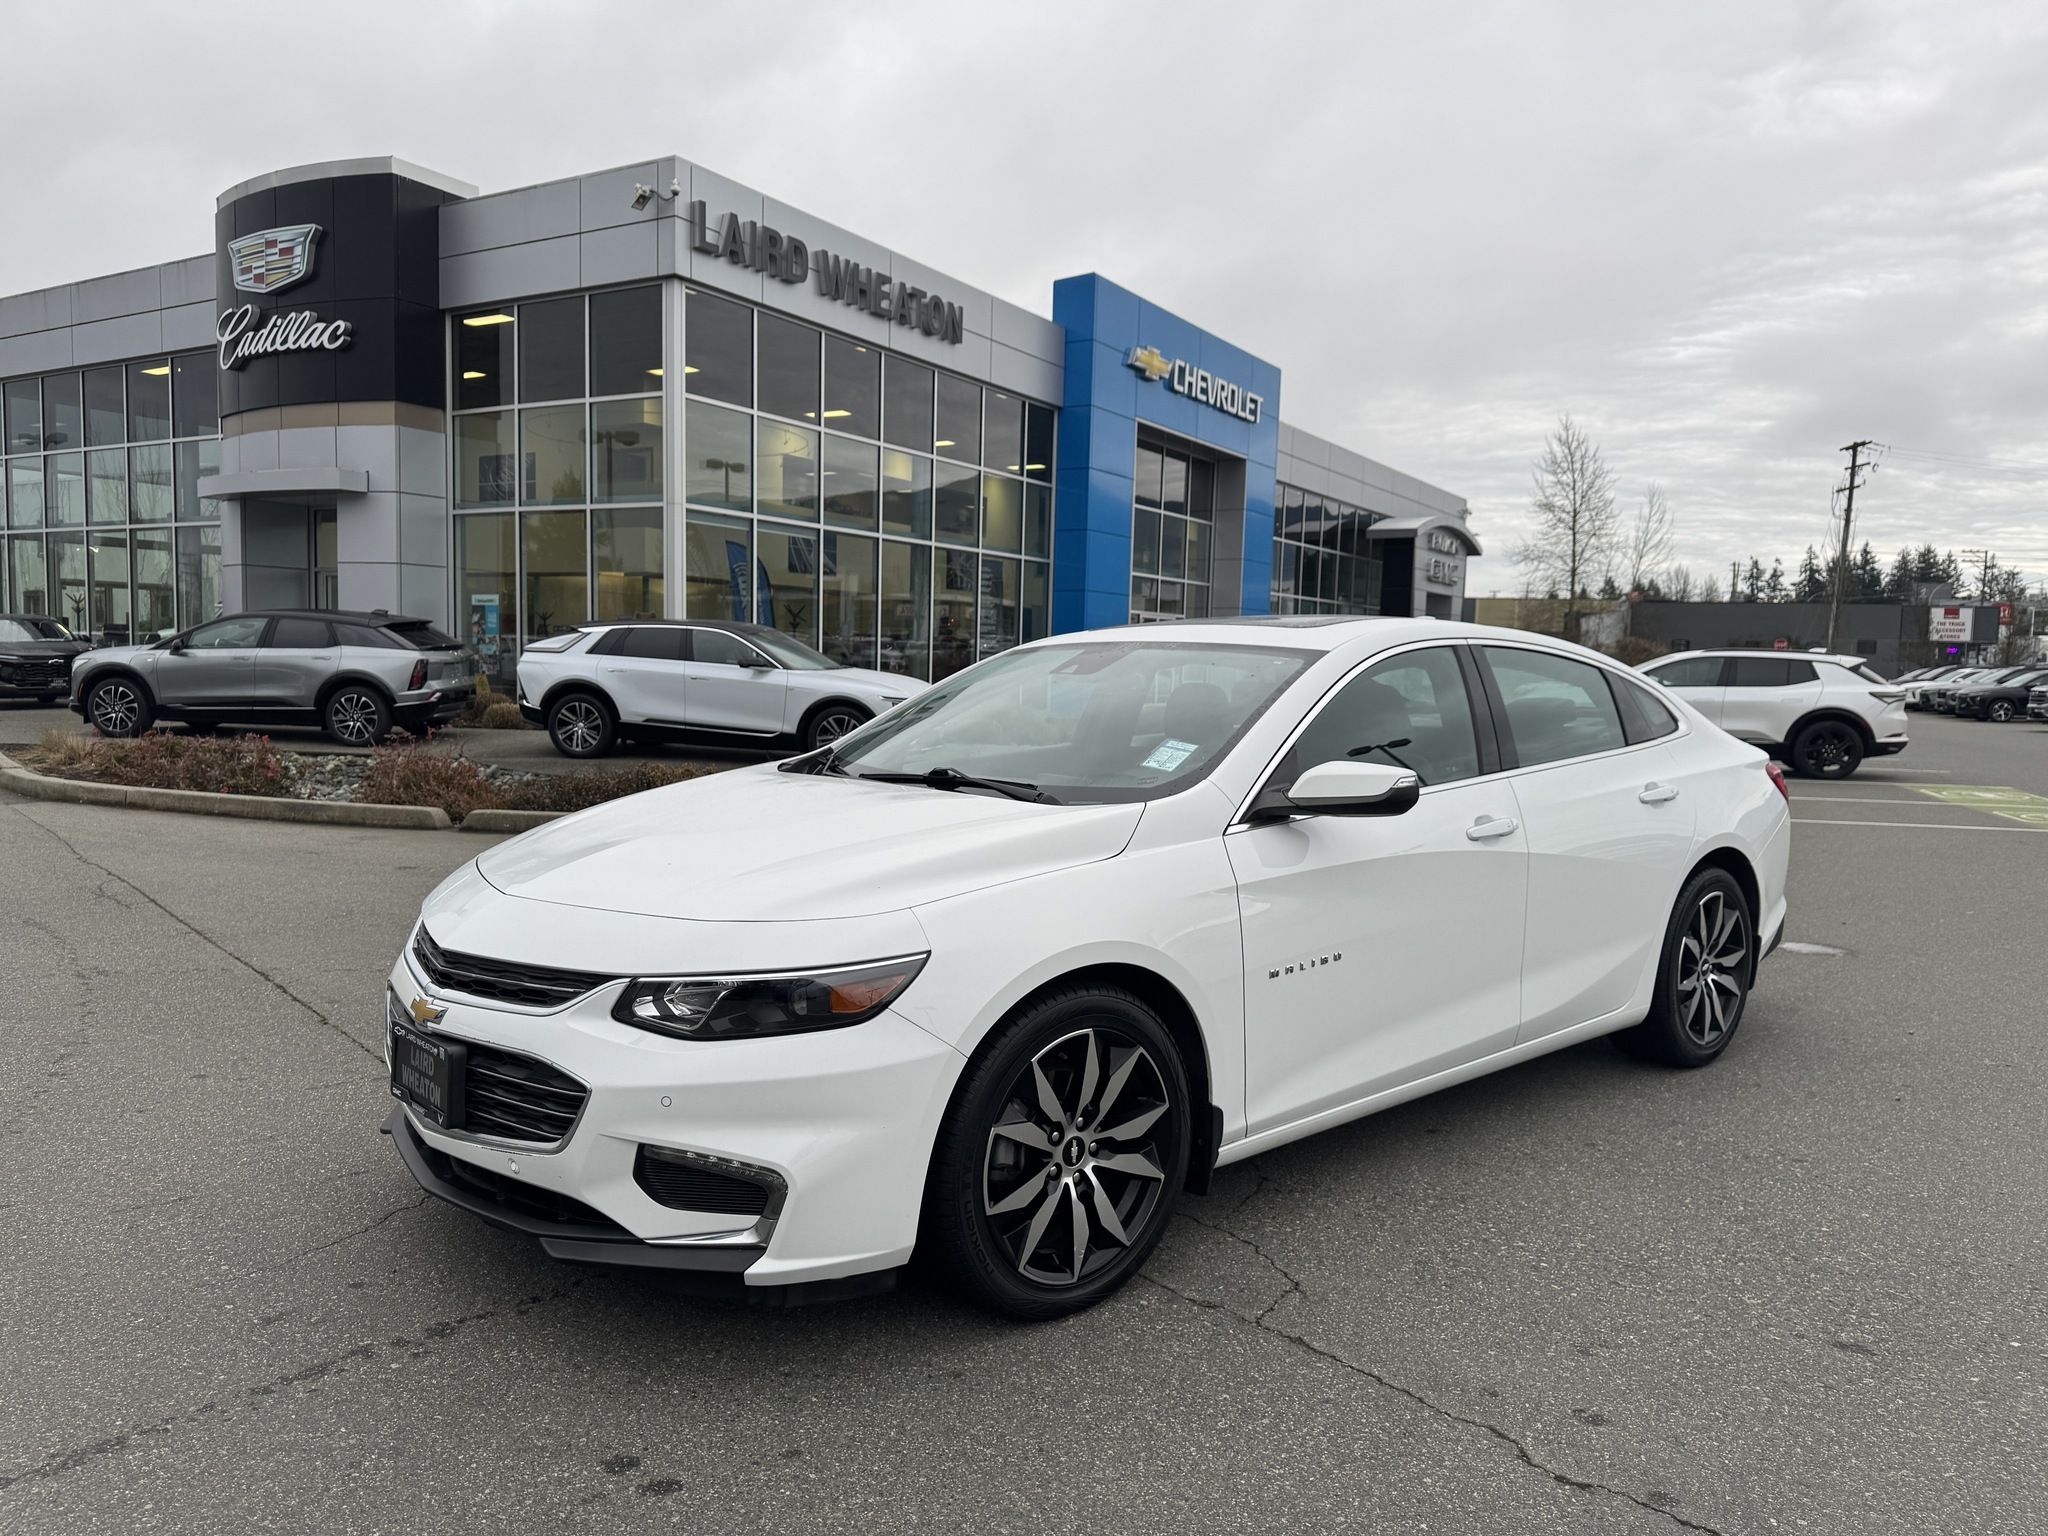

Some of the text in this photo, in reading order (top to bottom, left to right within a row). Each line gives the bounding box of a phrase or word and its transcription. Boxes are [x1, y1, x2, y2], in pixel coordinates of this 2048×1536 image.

[693, 199, 963, 345] LAIRD WHEATON
[216, 303, 349, 370] Cadillac
[1173, 358, 1264, 424] CHEVROLET
[1269, 951, 1342, 979] MALIBU
[402, 1063, 441, 1107] WHEATON
[410, 1045, 435, 1077] LAIRD
